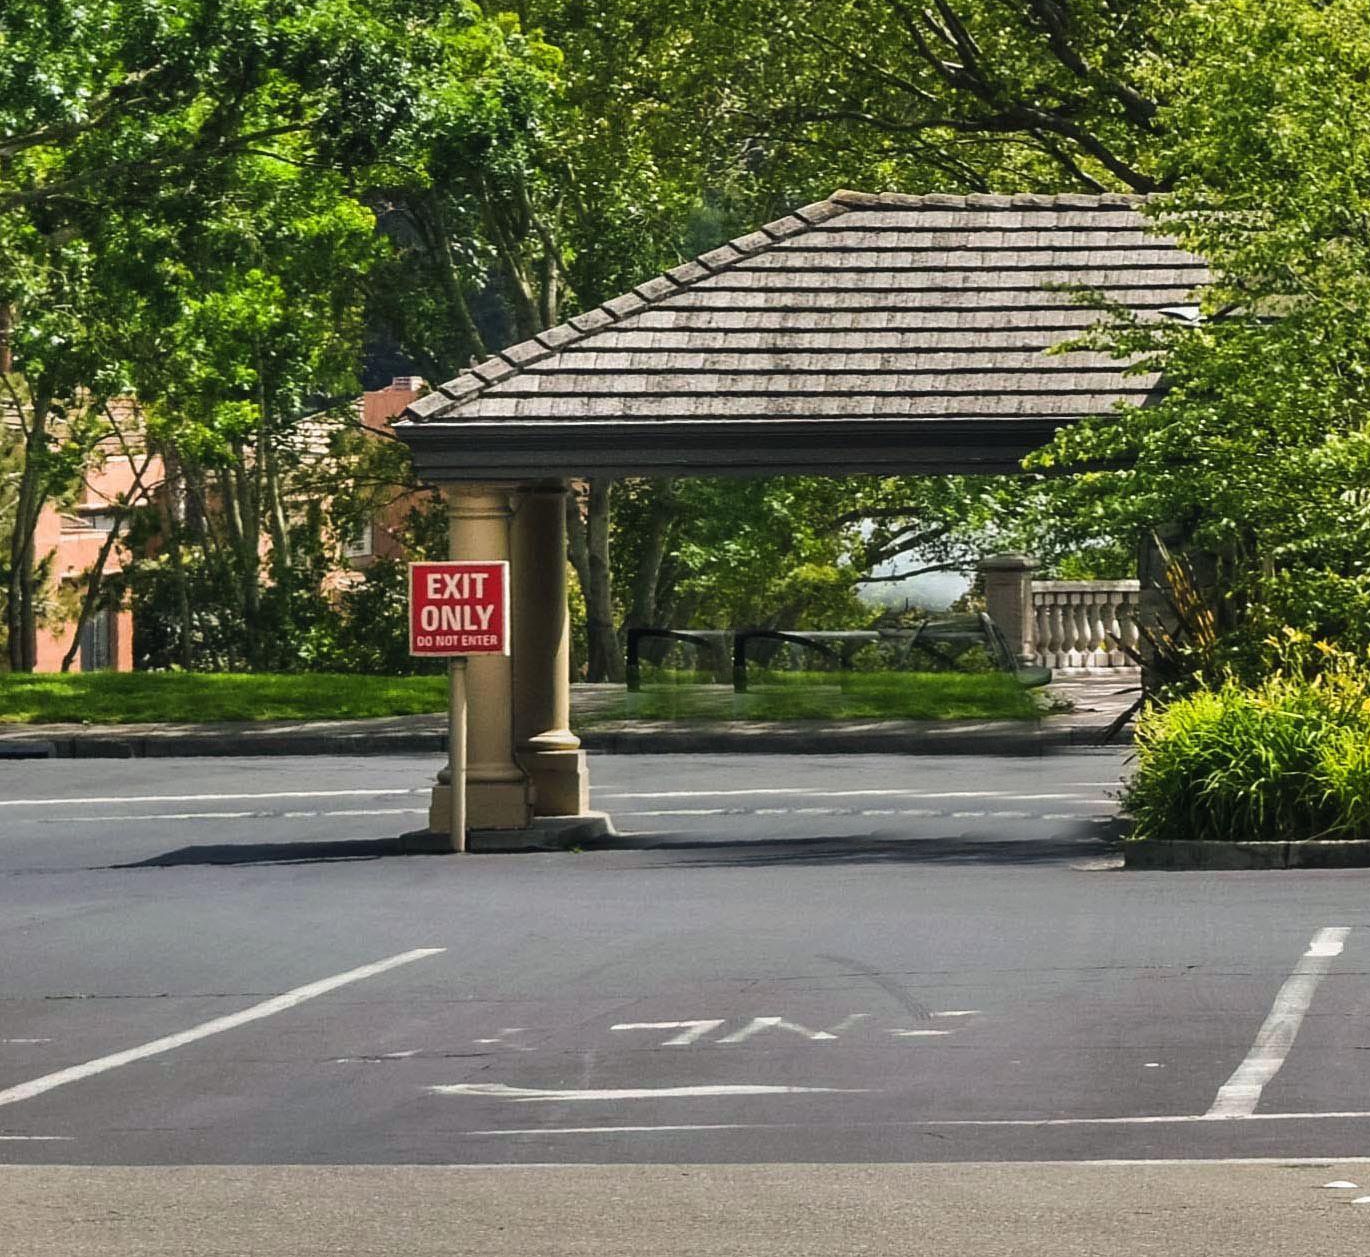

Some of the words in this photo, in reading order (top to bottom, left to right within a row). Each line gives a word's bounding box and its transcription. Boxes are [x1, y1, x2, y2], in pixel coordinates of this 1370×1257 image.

[426, 573, 489, 600] EXIT
[421, 604, 495, 631] ONLY
[416, 635, 433, 647] DO
[435, 635, 459, 647] NOT
[461, 634, 498, 647] ENTER
